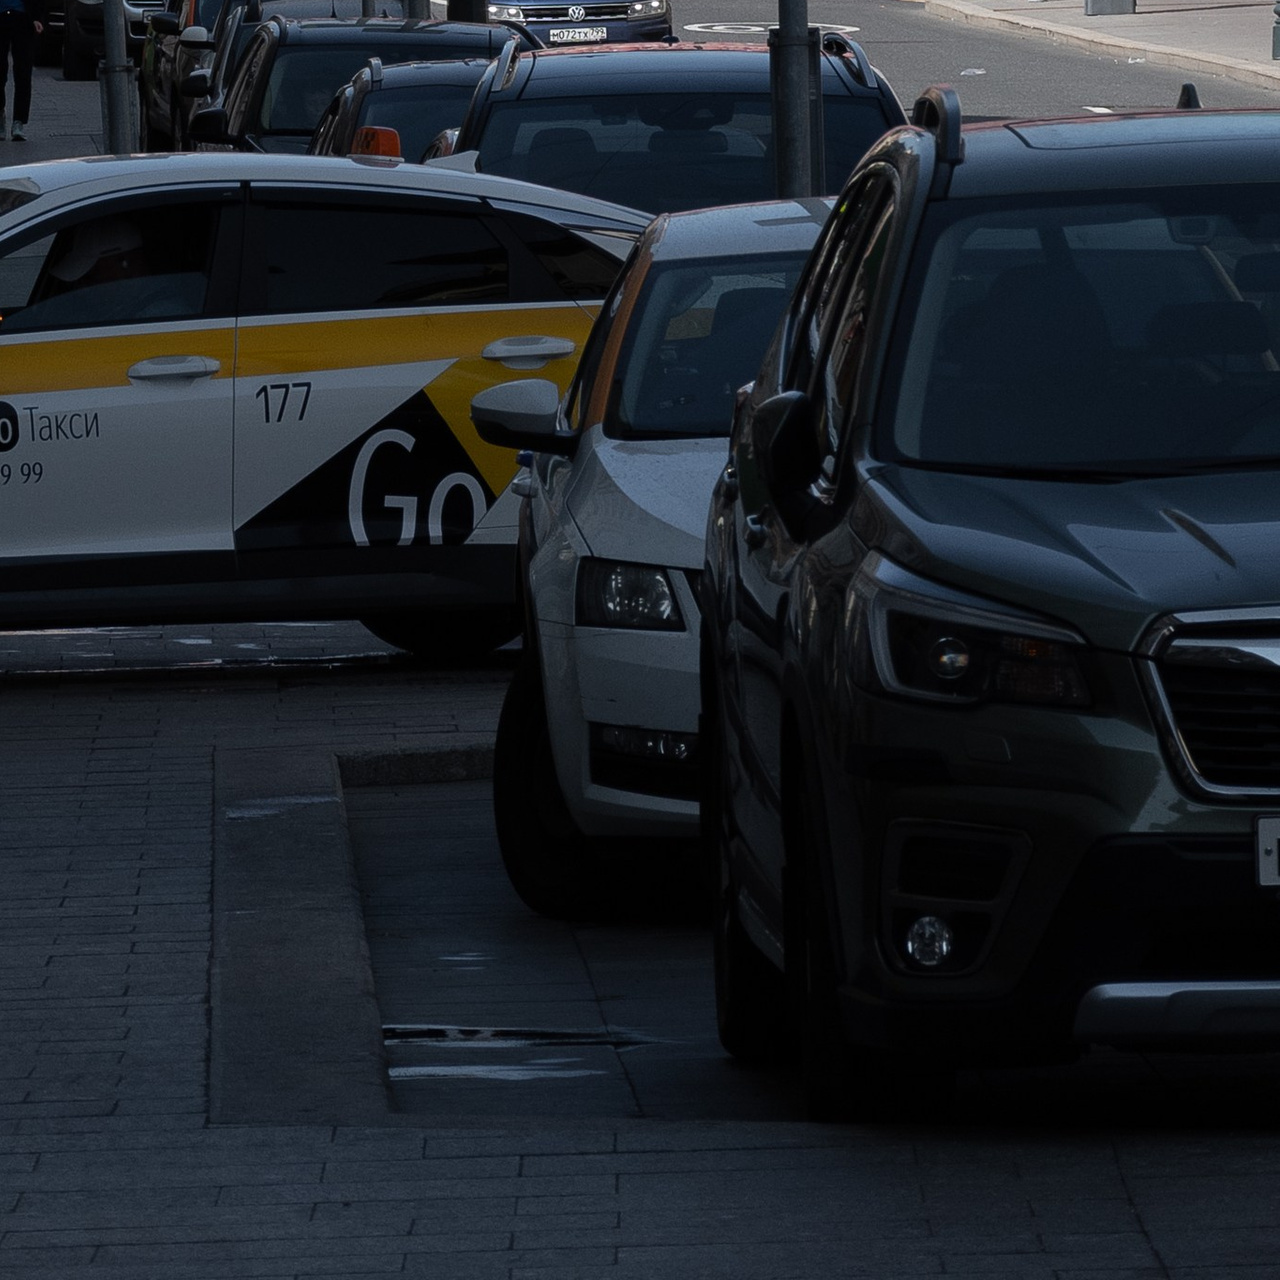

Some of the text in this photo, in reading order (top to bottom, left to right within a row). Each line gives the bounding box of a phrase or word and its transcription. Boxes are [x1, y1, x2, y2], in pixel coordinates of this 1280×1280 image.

[255, 381, 312, 424] 177
[23, 406, 100, 442] Такси
[20, 462, 44, 484] 99
[348, 427, 489, 547] Go
